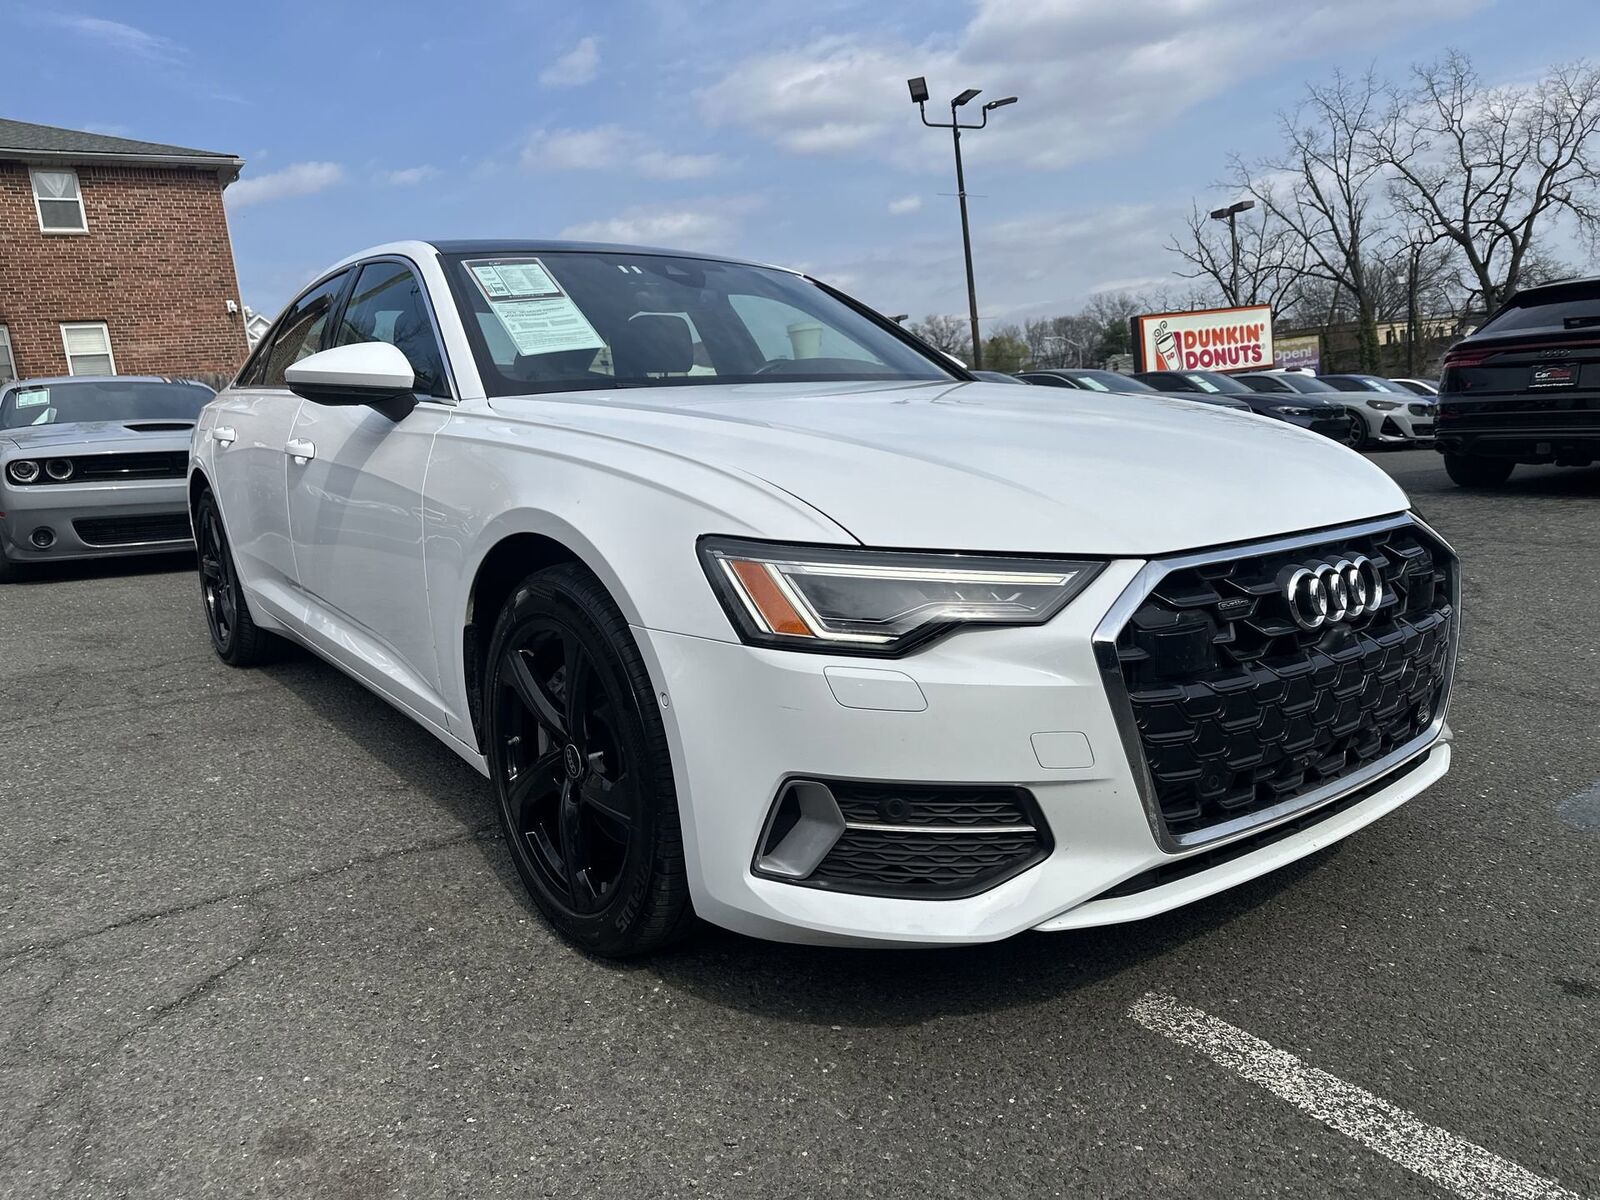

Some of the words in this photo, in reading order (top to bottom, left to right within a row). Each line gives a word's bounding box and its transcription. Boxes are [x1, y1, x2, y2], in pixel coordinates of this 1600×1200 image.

[1184, 324, 1264, 349] DUNKIN'
[1185, 344, 1263, 369] DONUTS
[1274, 346, 1312, 362] Open!
